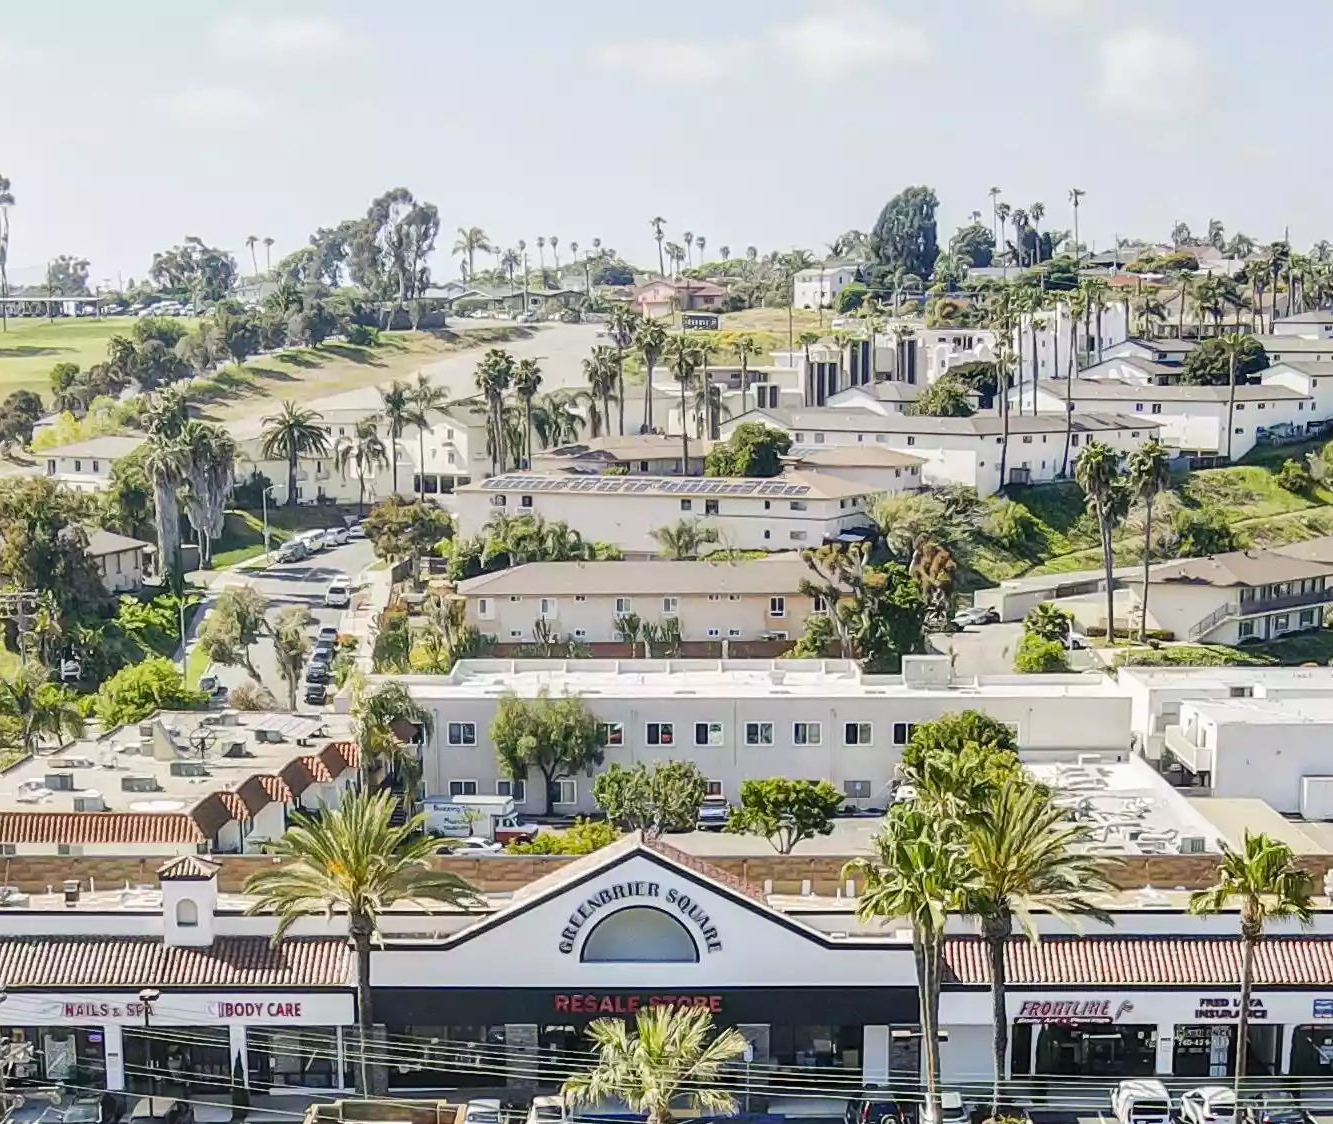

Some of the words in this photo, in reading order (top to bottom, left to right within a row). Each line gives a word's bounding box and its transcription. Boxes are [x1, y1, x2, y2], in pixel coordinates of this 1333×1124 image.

[559, 881, 660, 954] GREENBRIER
[666, 888, 723, 954] SQUARE
[66, 1003, 108, 1017] NAILS
[226, 1002, 263, 1017] BODY
[267, 1002, 302, 1017] CARE
[554, 994, 640, 1013] RESALE
[1020, 1000, 1110, 1015] FRONTLINE
